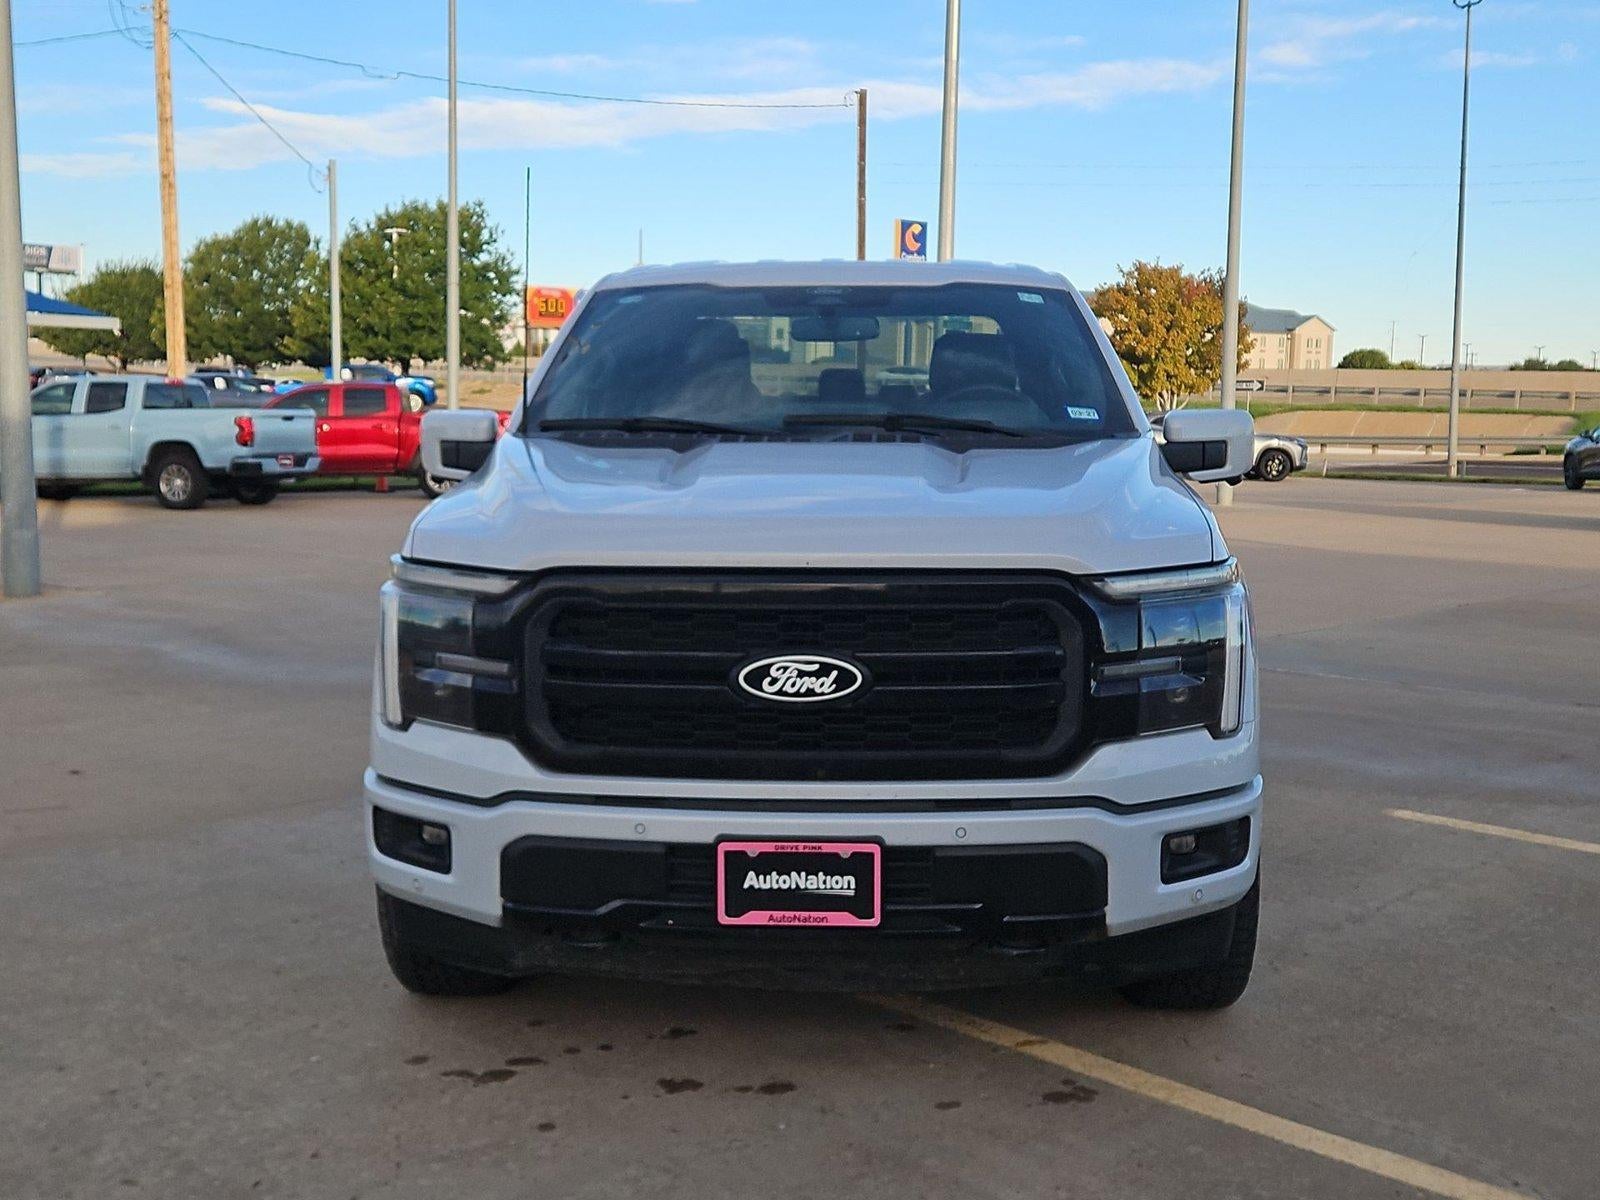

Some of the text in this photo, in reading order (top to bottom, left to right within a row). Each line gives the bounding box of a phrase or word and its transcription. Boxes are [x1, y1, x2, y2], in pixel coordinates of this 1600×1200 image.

[762, 662, 839, 694] Ford
[743, 870, 856, 890] AutoNation
[767, 913, 829, 924] AutoNation
